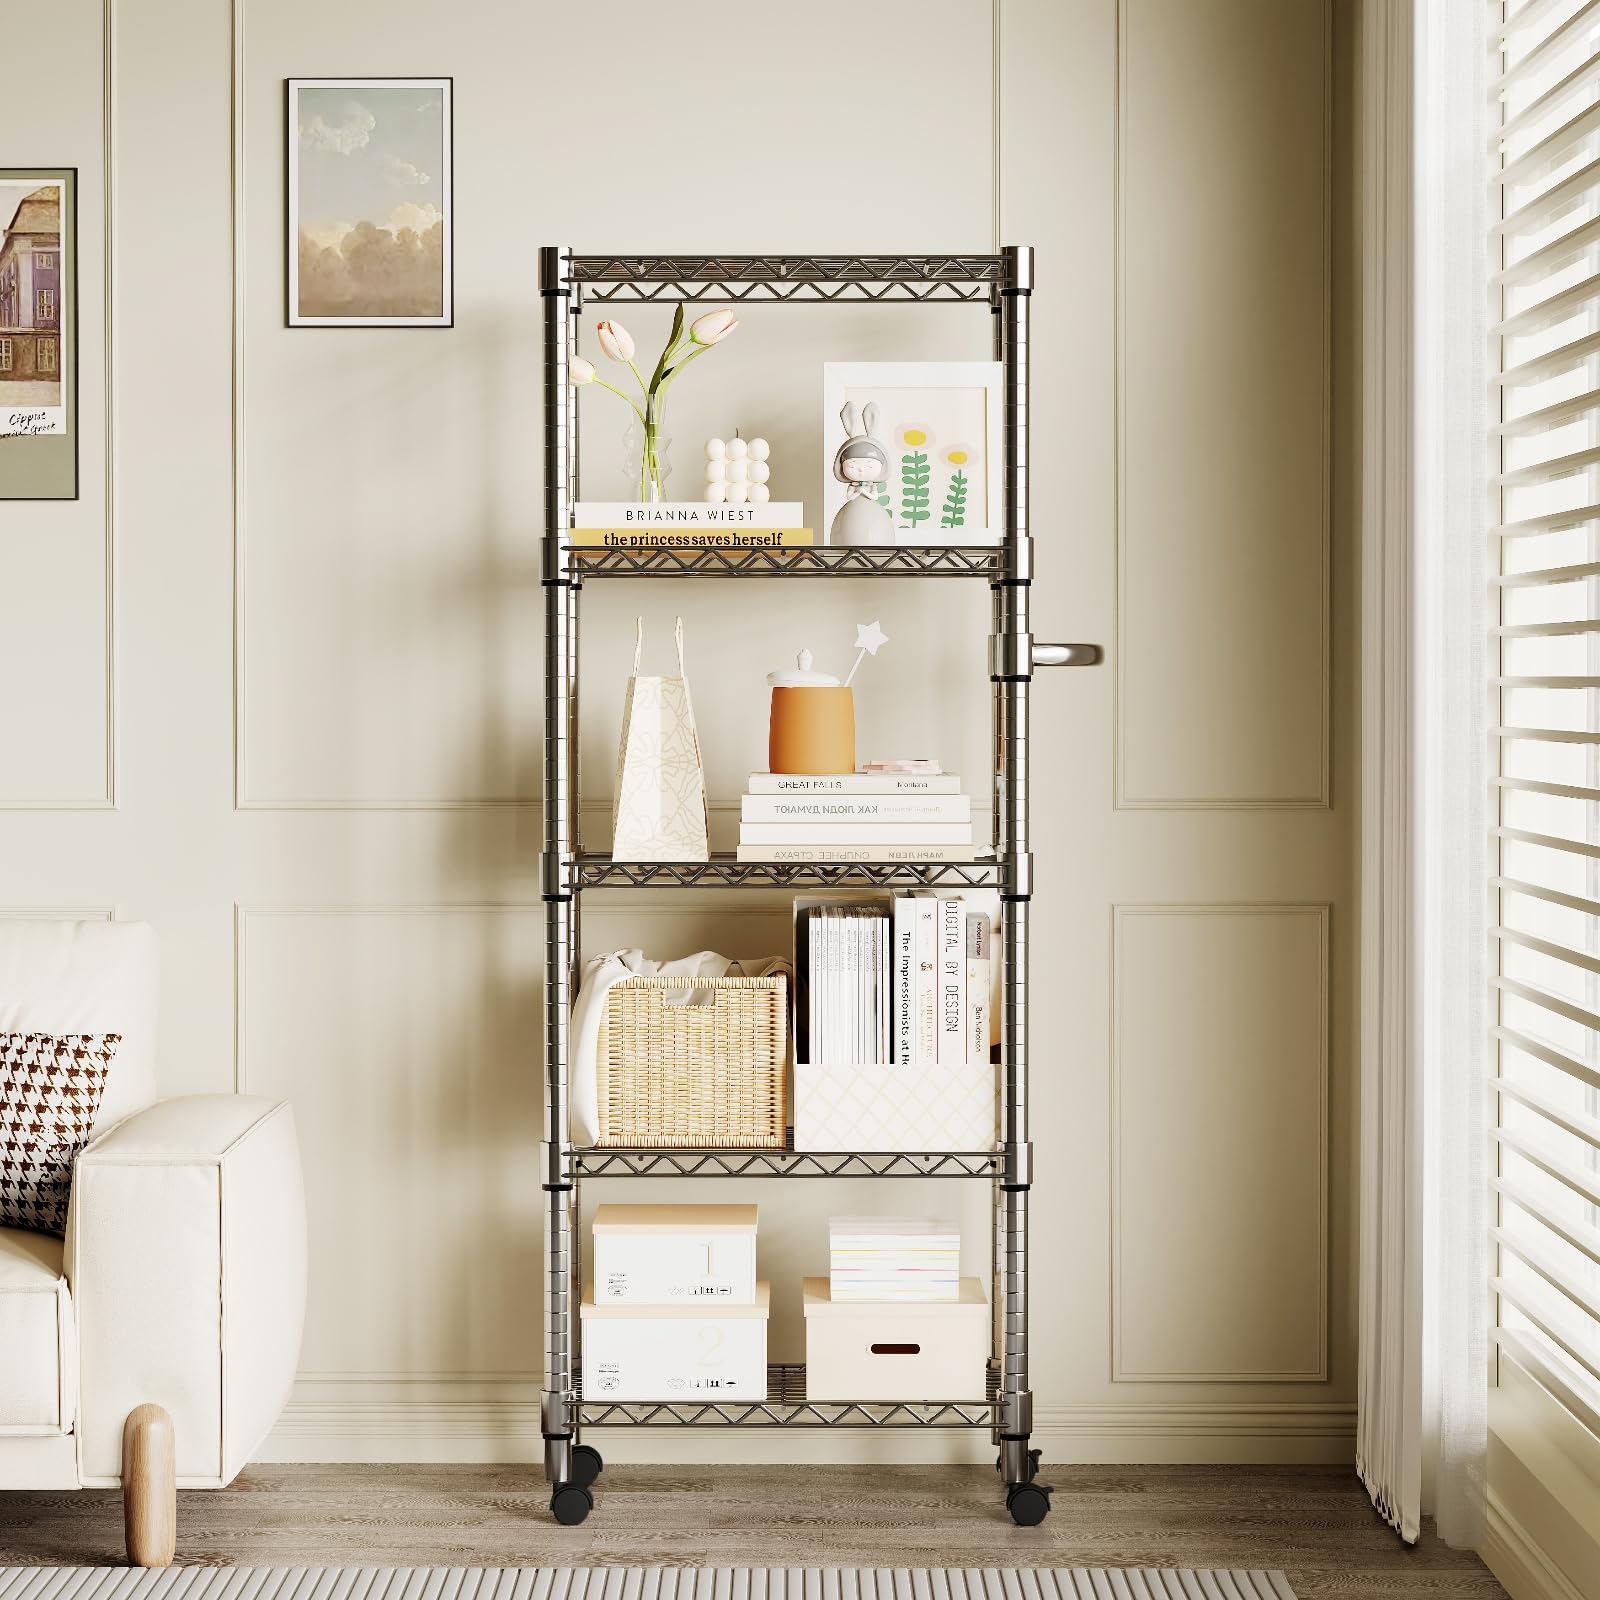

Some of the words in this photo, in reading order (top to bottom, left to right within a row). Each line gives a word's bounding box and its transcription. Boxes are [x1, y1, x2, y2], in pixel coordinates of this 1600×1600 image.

[626, 510, 699, 521] BRIANNA
[707, 510, 754, 521] WIEST
[603, 533, 628, 546] the
[629, 533, 690, 546] princess
[691, 534, 731, 546] saves
[731, 532, 784, 546] herself
[777, 781, 810, 789] GREAT
[813, 781, 842, 789] FALLS
[945, 901, 958, 953] DIGITAL
[901, 931, 911, 952] The
[945, 961, 958, 977] BY
[899, 955, 911, 1036] Impressionists
[945, 985, 959, 1032] DESIGN
[901, 1039, 911, 1051] at
